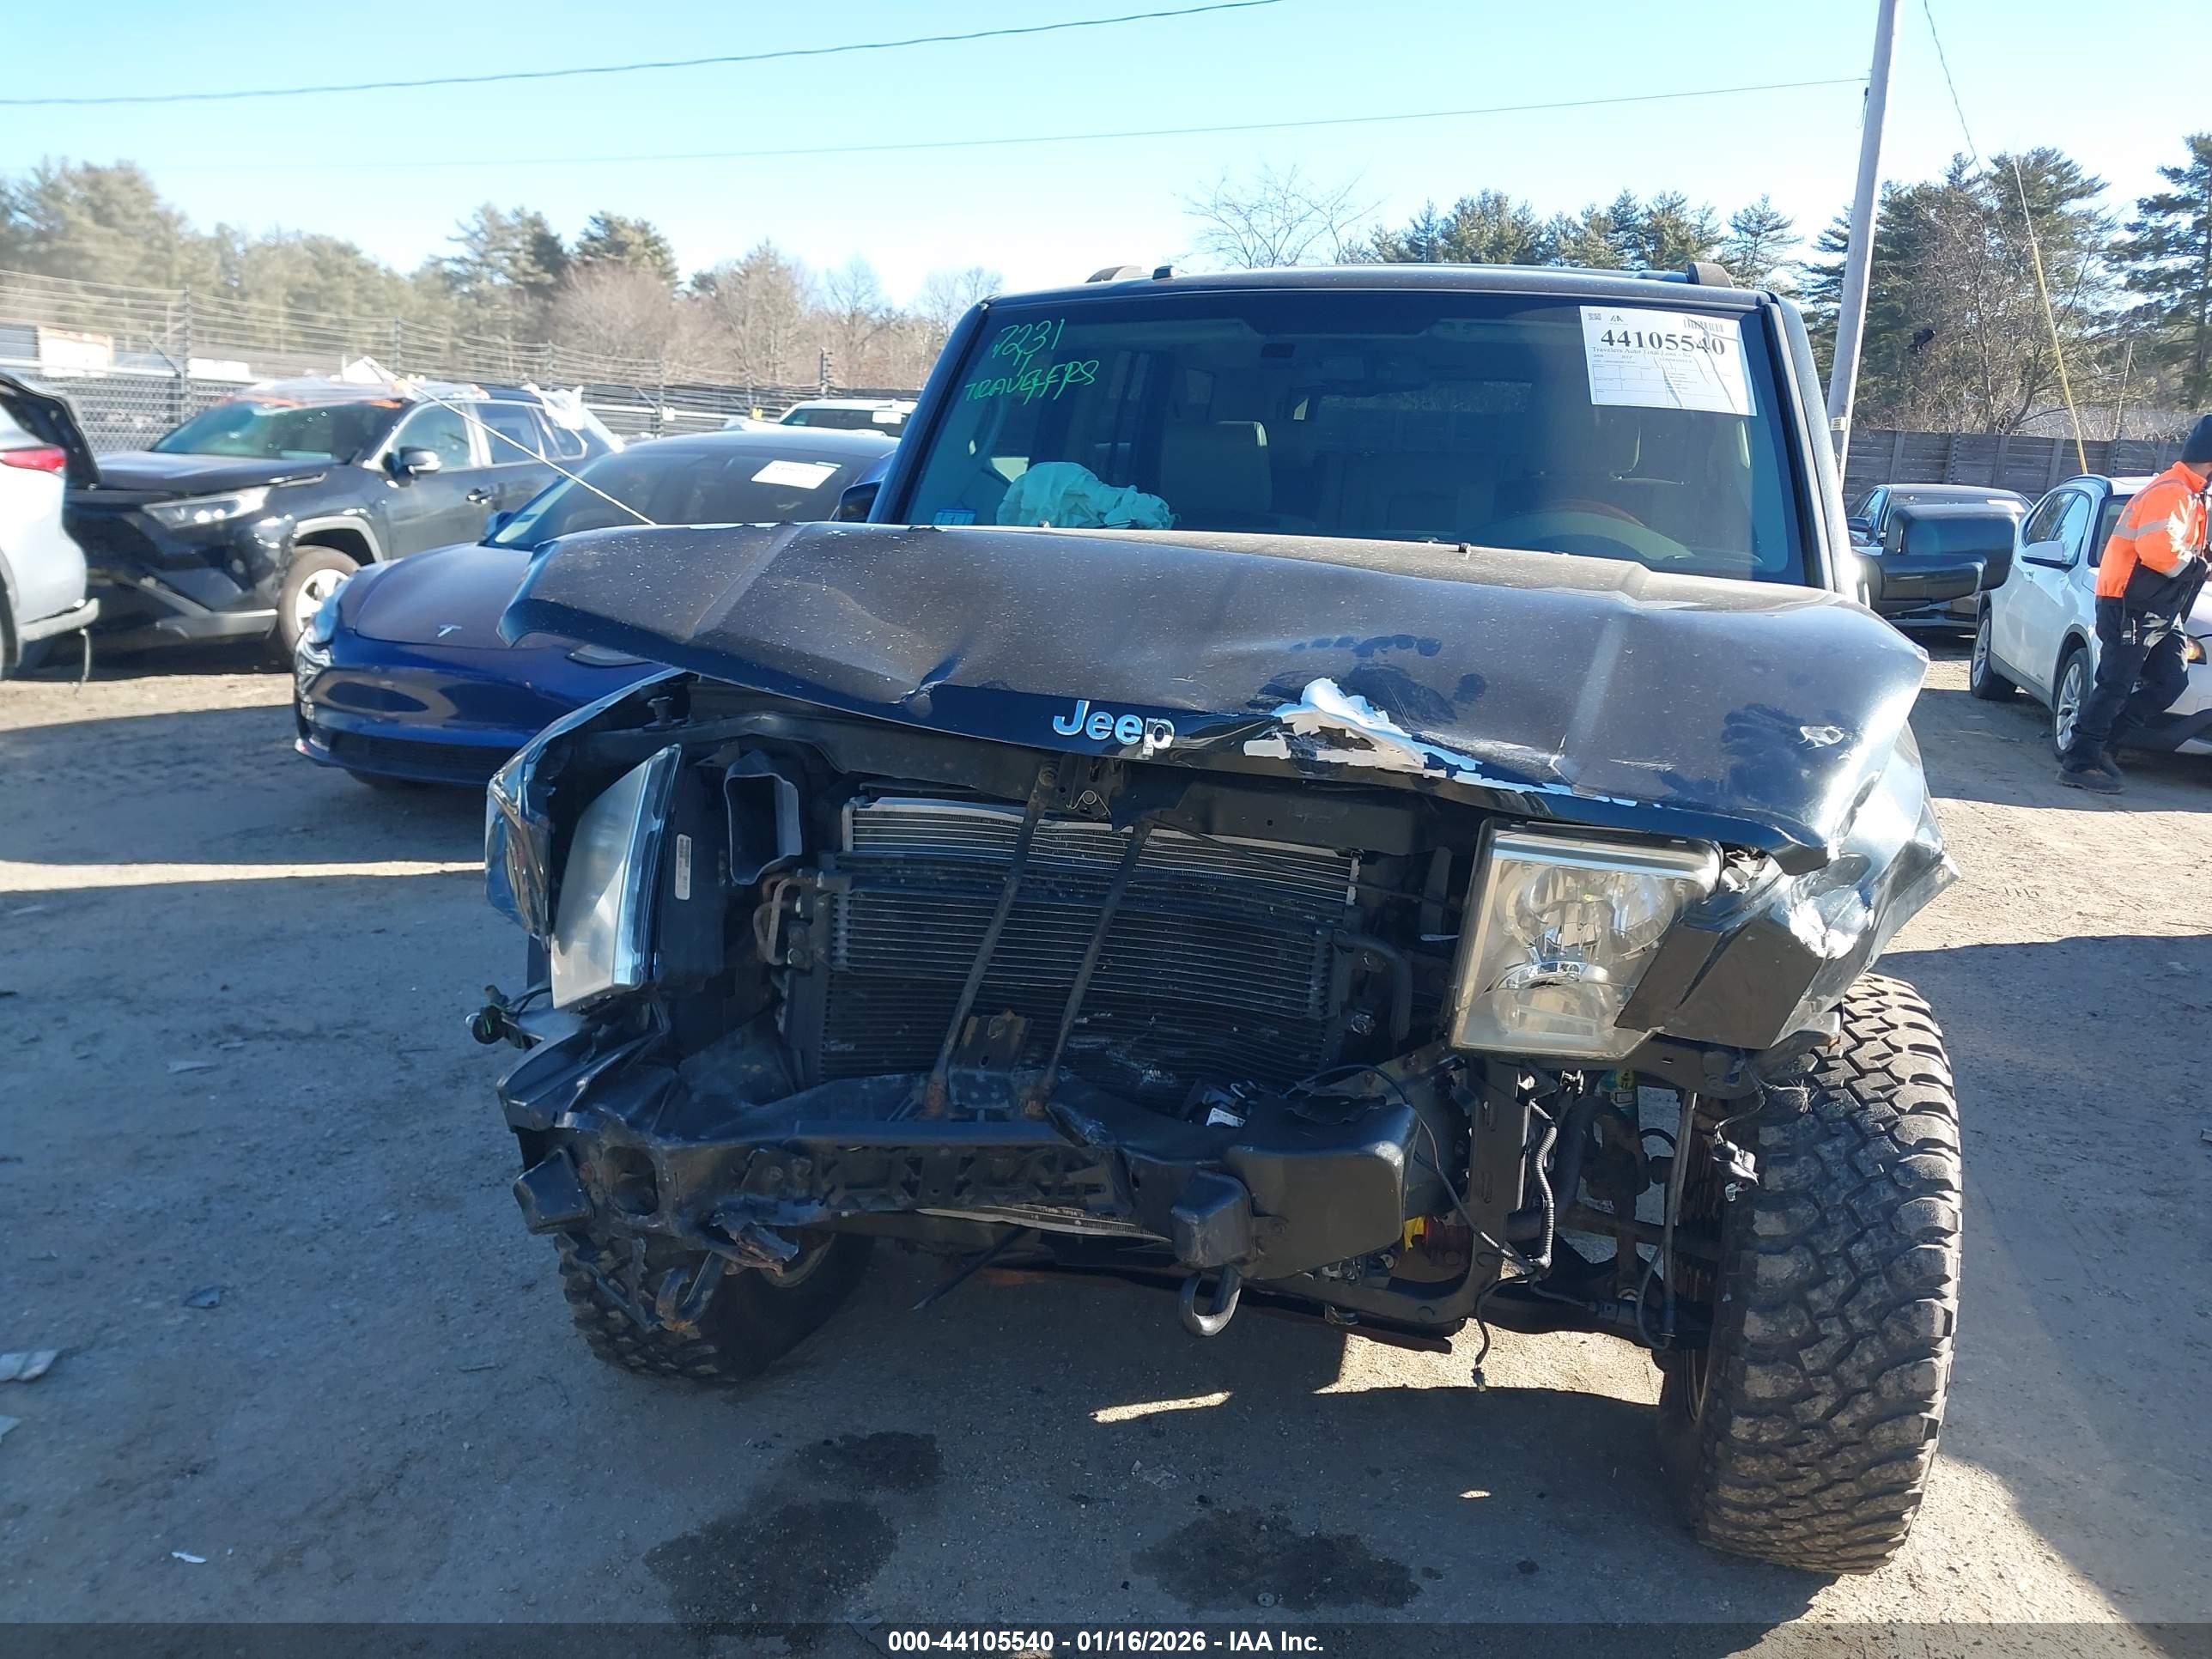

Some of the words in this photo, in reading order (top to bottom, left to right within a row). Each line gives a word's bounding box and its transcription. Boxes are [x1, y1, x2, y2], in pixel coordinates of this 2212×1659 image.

[1601, 329, 1726, 356] 44105540
[964, 360, 1100, 404] TRAVELERS
[1053, 699, 1176, 757] Jeep
